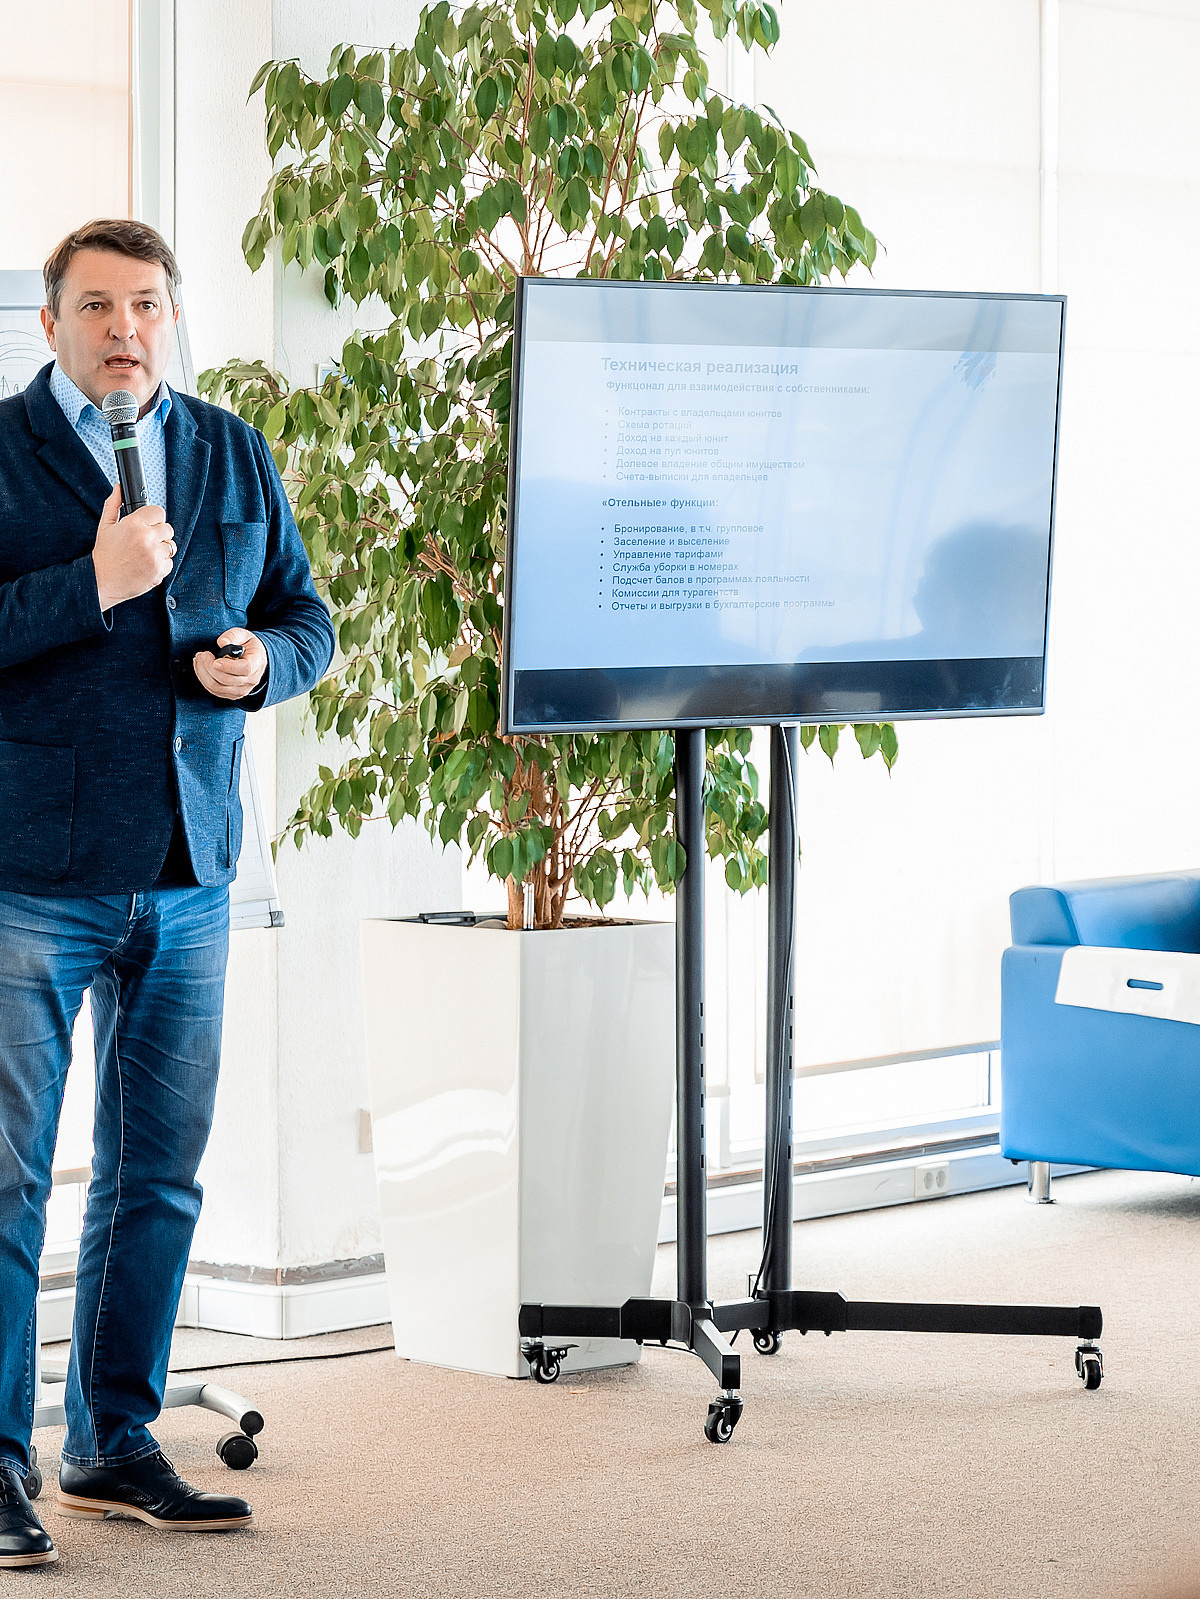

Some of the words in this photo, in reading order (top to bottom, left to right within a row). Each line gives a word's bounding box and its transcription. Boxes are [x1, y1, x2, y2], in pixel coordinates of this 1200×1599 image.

[601, 358, 701, 373] Техническая
[706, 361, 798, 376] реализация
[606, 381, 665, 391] Функцонал
[667, 383, 687, 392] для
[690, 382, 774, 393] взаимодействия
[785, 384, 870, 395] собственниками:
[618, 407, 670, 417] Контракты
[681, 409, 745, 419] владельцами
[747, 410, 782, 418] юнитов
[618, 420, 650, 429] Схема
[652, 420, 692, 431] ротаций
[617, 433, 648, 443] Доход
[665, 433, 702, 443] каждый
[704, 435, 729, 443] юнит
[616, 446, 647, 456] Доход
[665, 447, 681, 457] пул
[684, 447, 719, 455] юнитов
[616, 458, 659, 469] Долевое
[661, 460, 708, 469] владение
[710, 459, 744, 469] общим
[746, 461, 805, 470] имуществом
[616, 472, 689, 482] Счета-выписки
[691, 473, 710, 481] для
[712, 473, 768, 482] владельцев
[601, 498, 667, 508] «Отельные»
[670, 498, 719, 510] функции:
[614, 524, 688, 535] Бронирование,
[716, 525, 764, 534] групповое
[614, 536, 666, 546] Заселение
[678, 538, 730, 546] выселение
[613, 550, 671, 560] Управление
[674, 550, 724, 560] тарифами
[612, 562, 651, 572] Служба
[654, 563, 687, 573] уборки
[698, 563, 739, 572] номерах
[612, 575, 653, 585] Подсчет
[655, 575, 685, 584] балов
[696, 576, 753, 585] программах
[755, 575, 810, 583] лояльности
[612, 589, 660, 598] Комиссии
[662, 589, 680, 598] для
[683, 588, 739, 598] турагентств
[611, 601, 648, 611] Отчеты
[660, 602, 703, 611] выгрузки
[705, 601, 711, 609] в
[714, 599, 780, 610] бухгалтерские
[783, 600, 836, 609] программы
